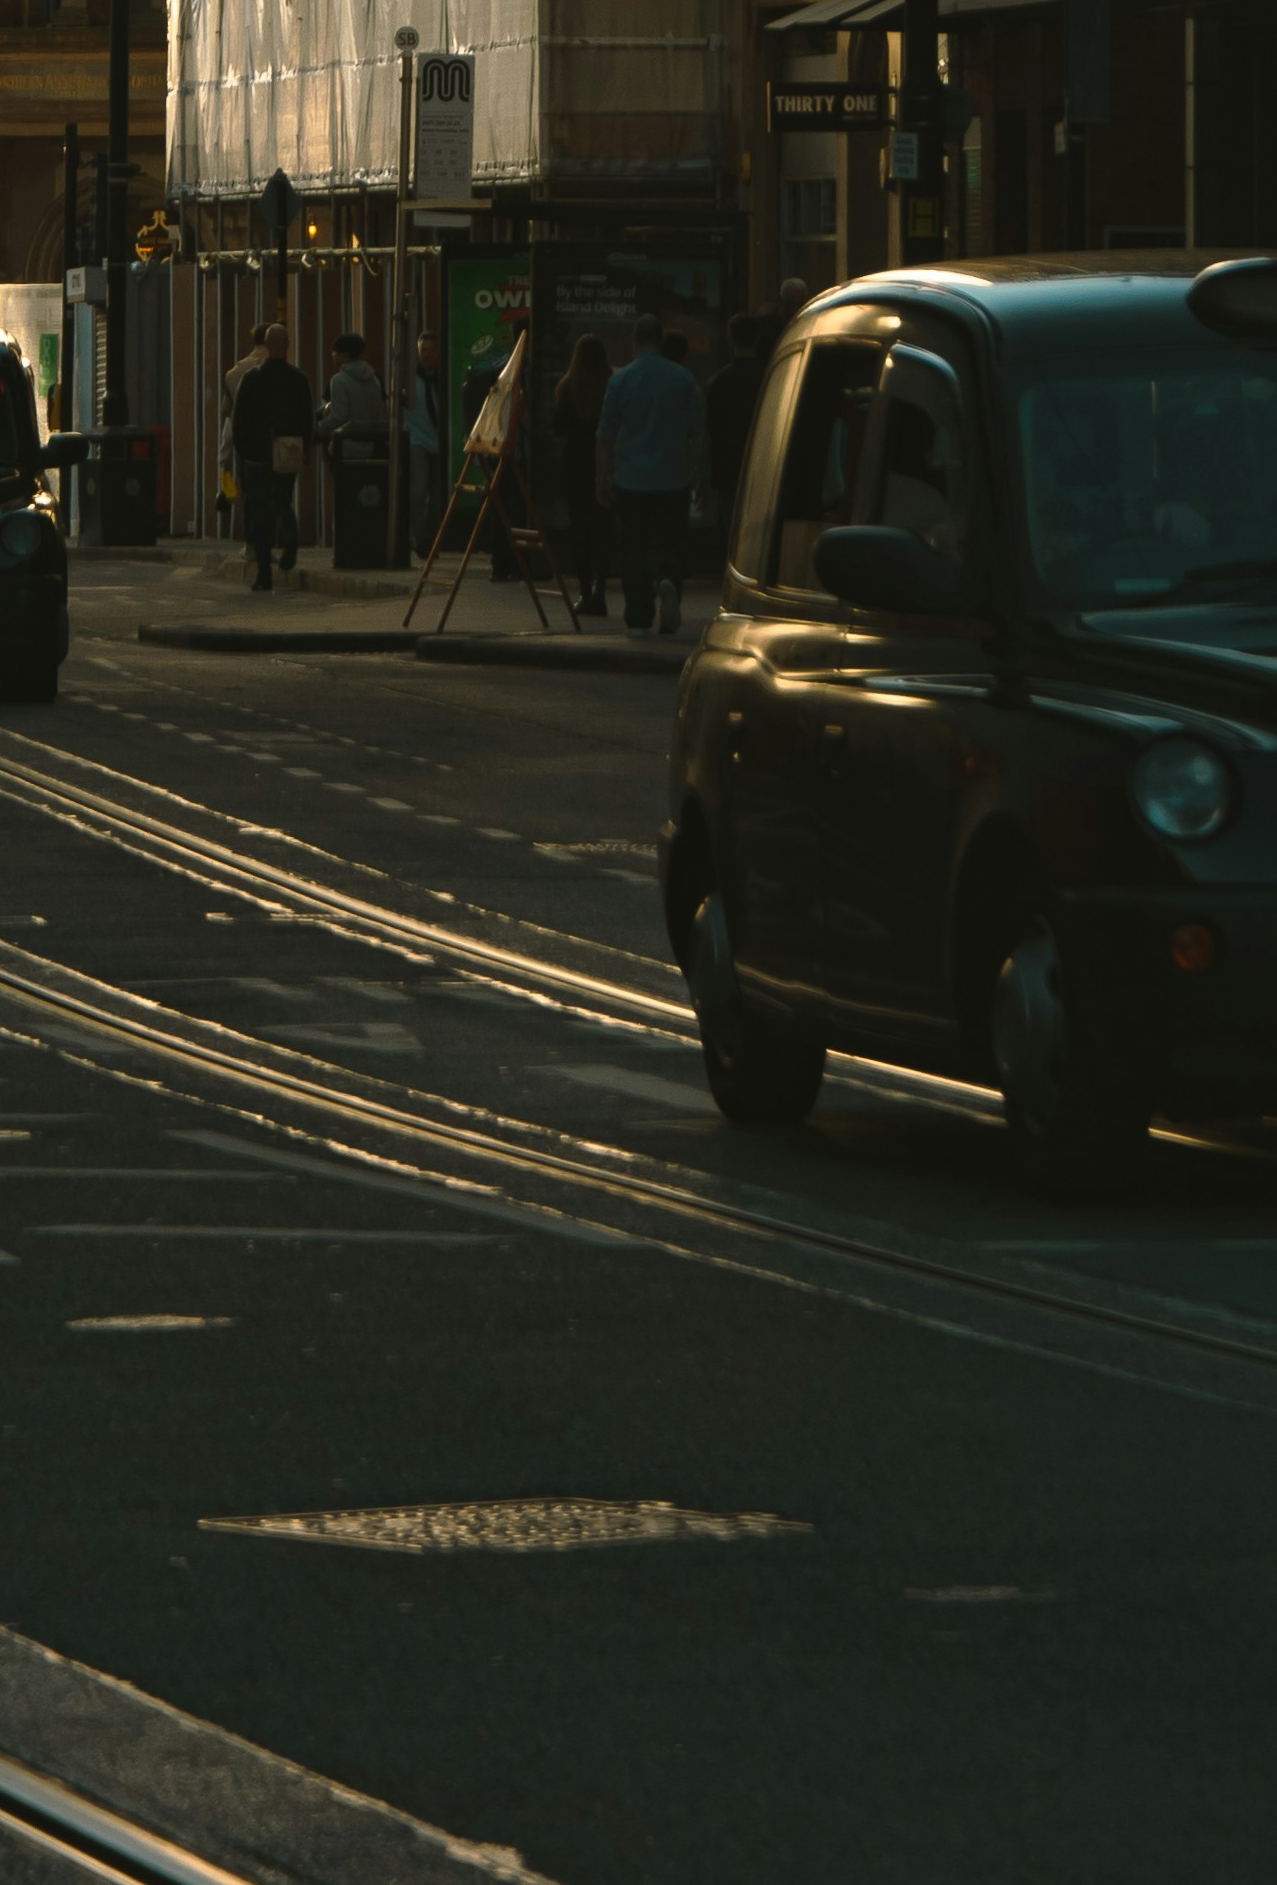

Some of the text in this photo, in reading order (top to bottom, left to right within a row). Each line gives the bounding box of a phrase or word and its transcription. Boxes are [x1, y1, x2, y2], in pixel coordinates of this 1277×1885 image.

[398, 32, 417, 46] SB
[774, 94, 877, 113] THIRTY ONE
[911, 199, 937, 233] H
[556, 284, 637, 299] By the side of
[556, 300, 637, 316] Island Delight
